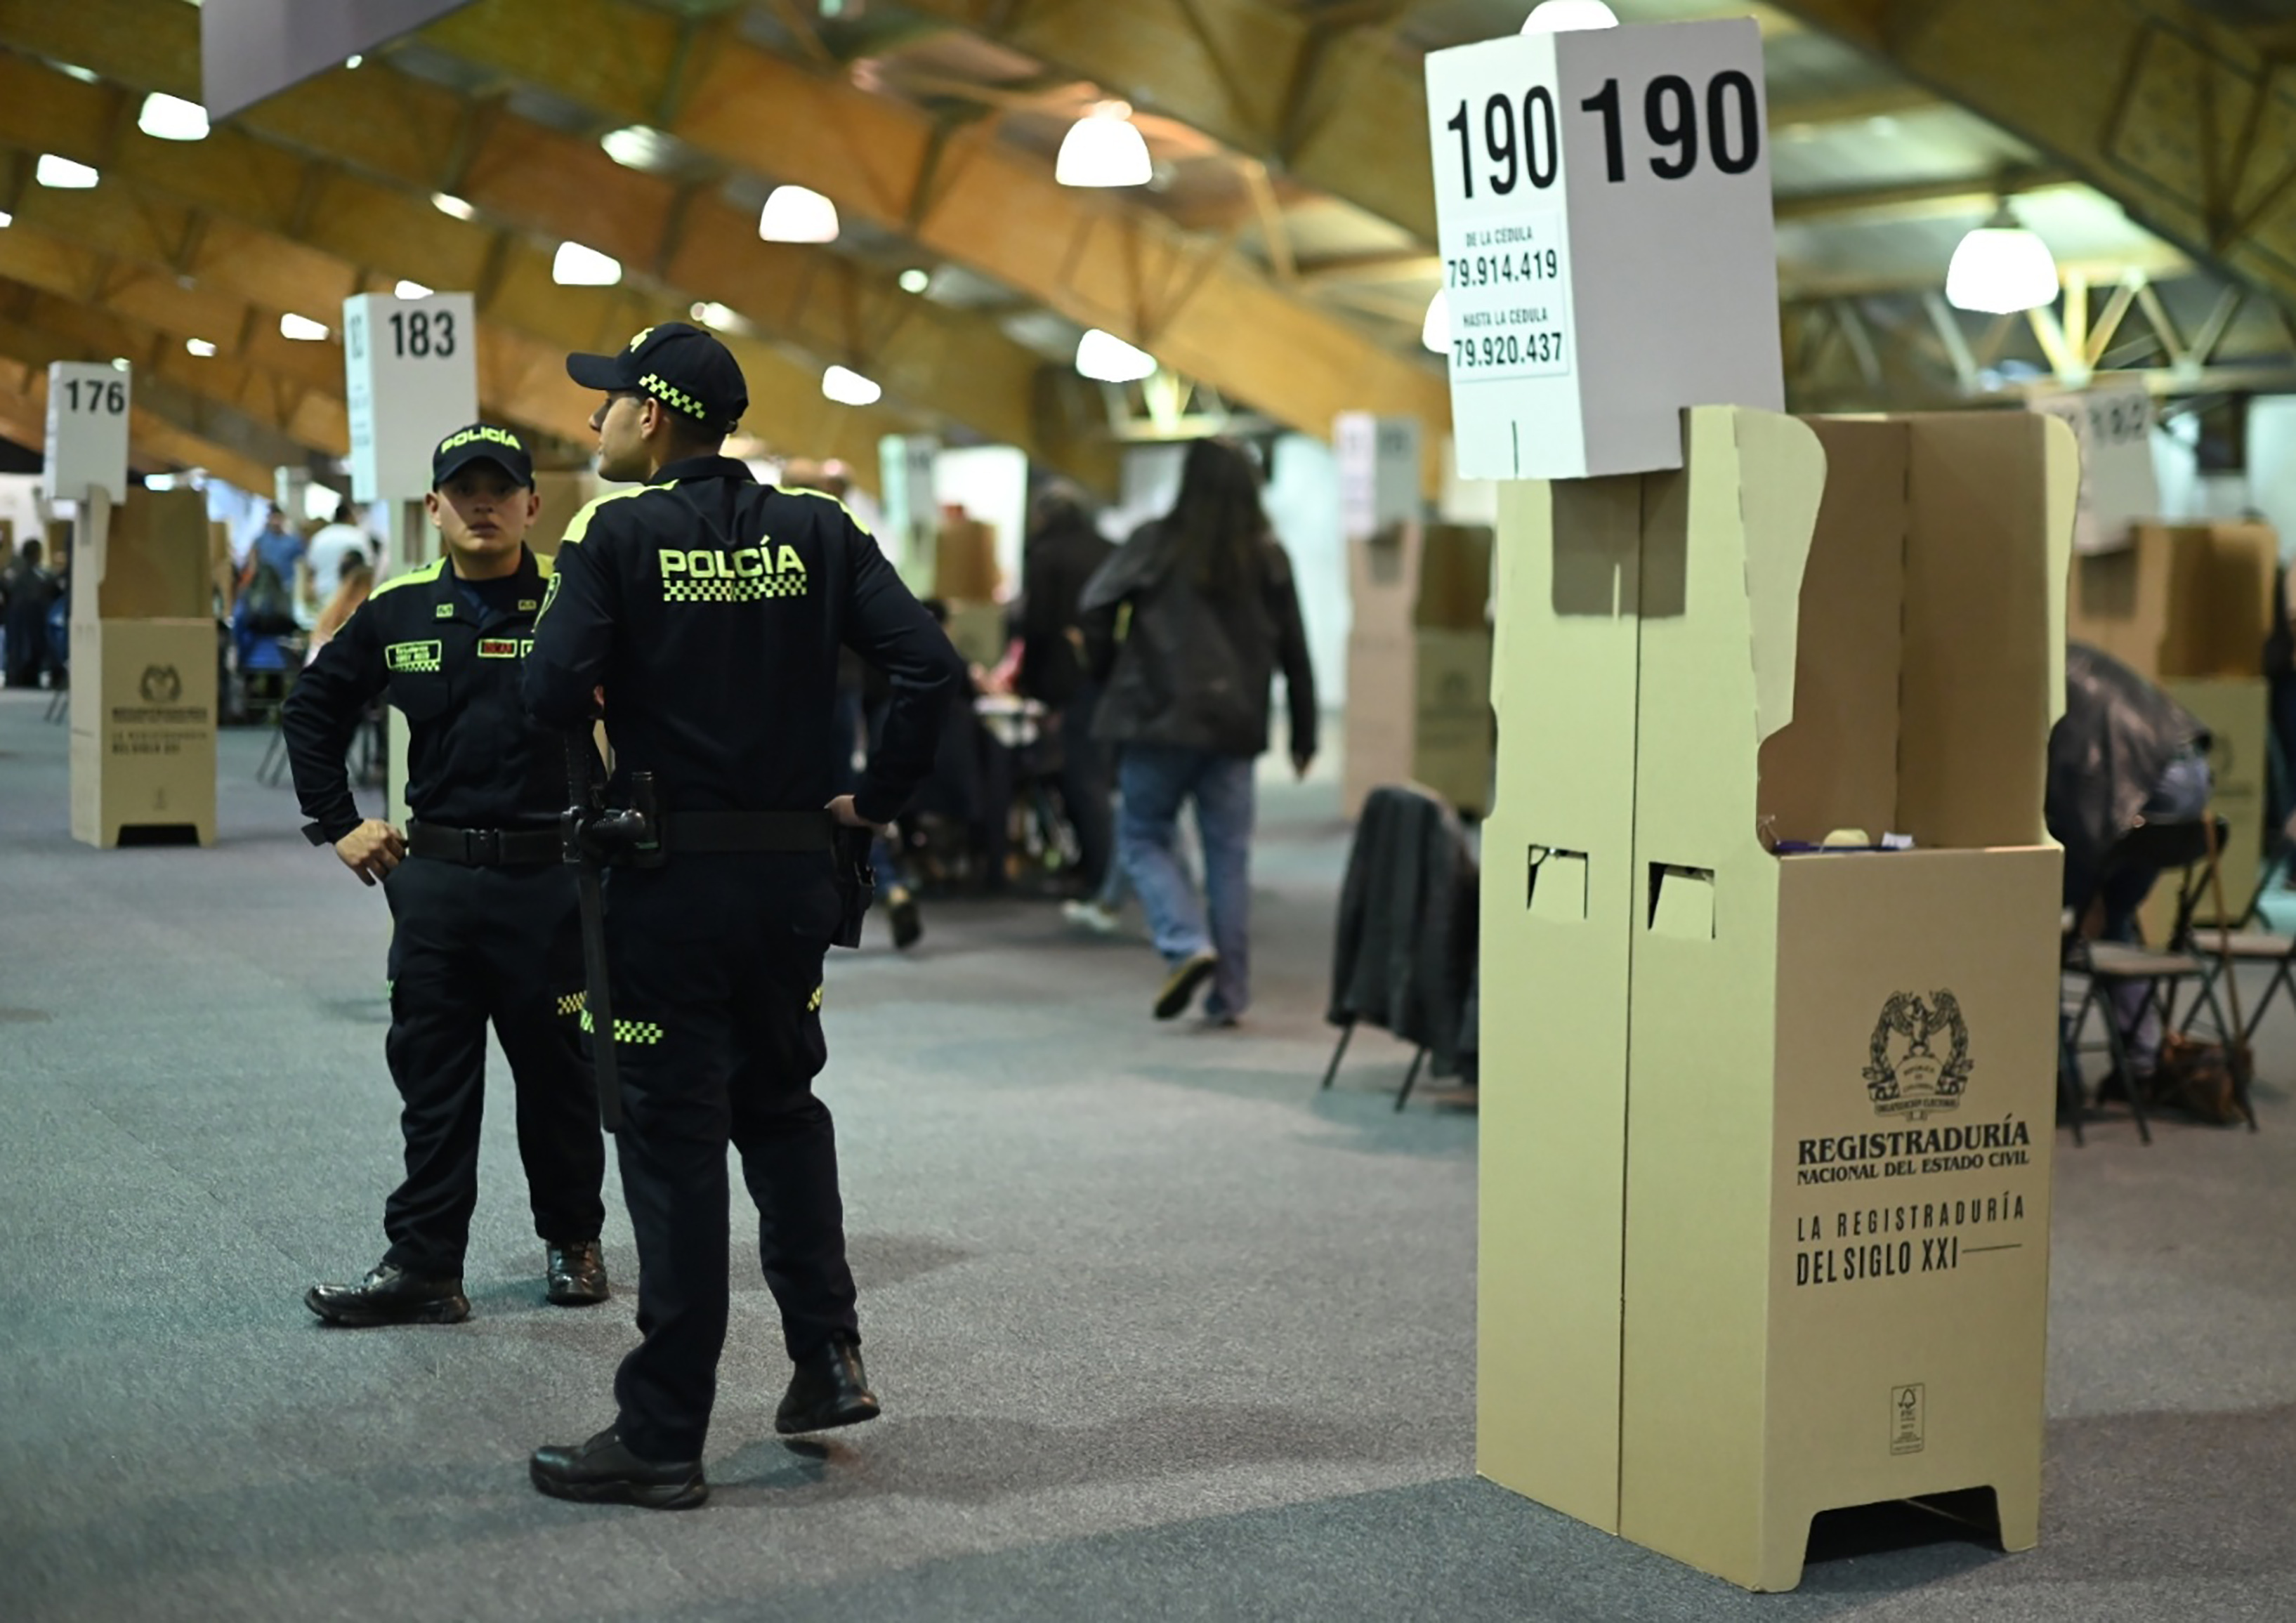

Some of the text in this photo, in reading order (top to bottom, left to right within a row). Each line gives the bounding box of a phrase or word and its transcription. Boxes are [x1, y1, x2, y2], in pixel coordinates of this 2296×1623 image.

[1448, 85, 1558, 199] 190
[1580, 69, 1760, 183] 190
[1466, 232, 1477, 248] DE
[1480, 230, 1491, 246] LA
[1448, 249, 1558, 289] 79.914.419
[389, 309, 455, 360] 183
[1463, 312, 1491, 328] HASTA
[1495, 310, 1506, 326] LA
[1454, 331, 1562, 368] 79.920.437
[65, 379, 125, 416] 176
[1798, 1112, 2031, 1165] REGISTRADURÍA
[1797, 1150, 2030, 1185] NACIONAL DEL ESTADO CIVIL
[1797, 1191, 2024, 1242] LA REGISTRADURÍA
[1797, 1235, 1957, 1287] DEL SIGLO XXI
